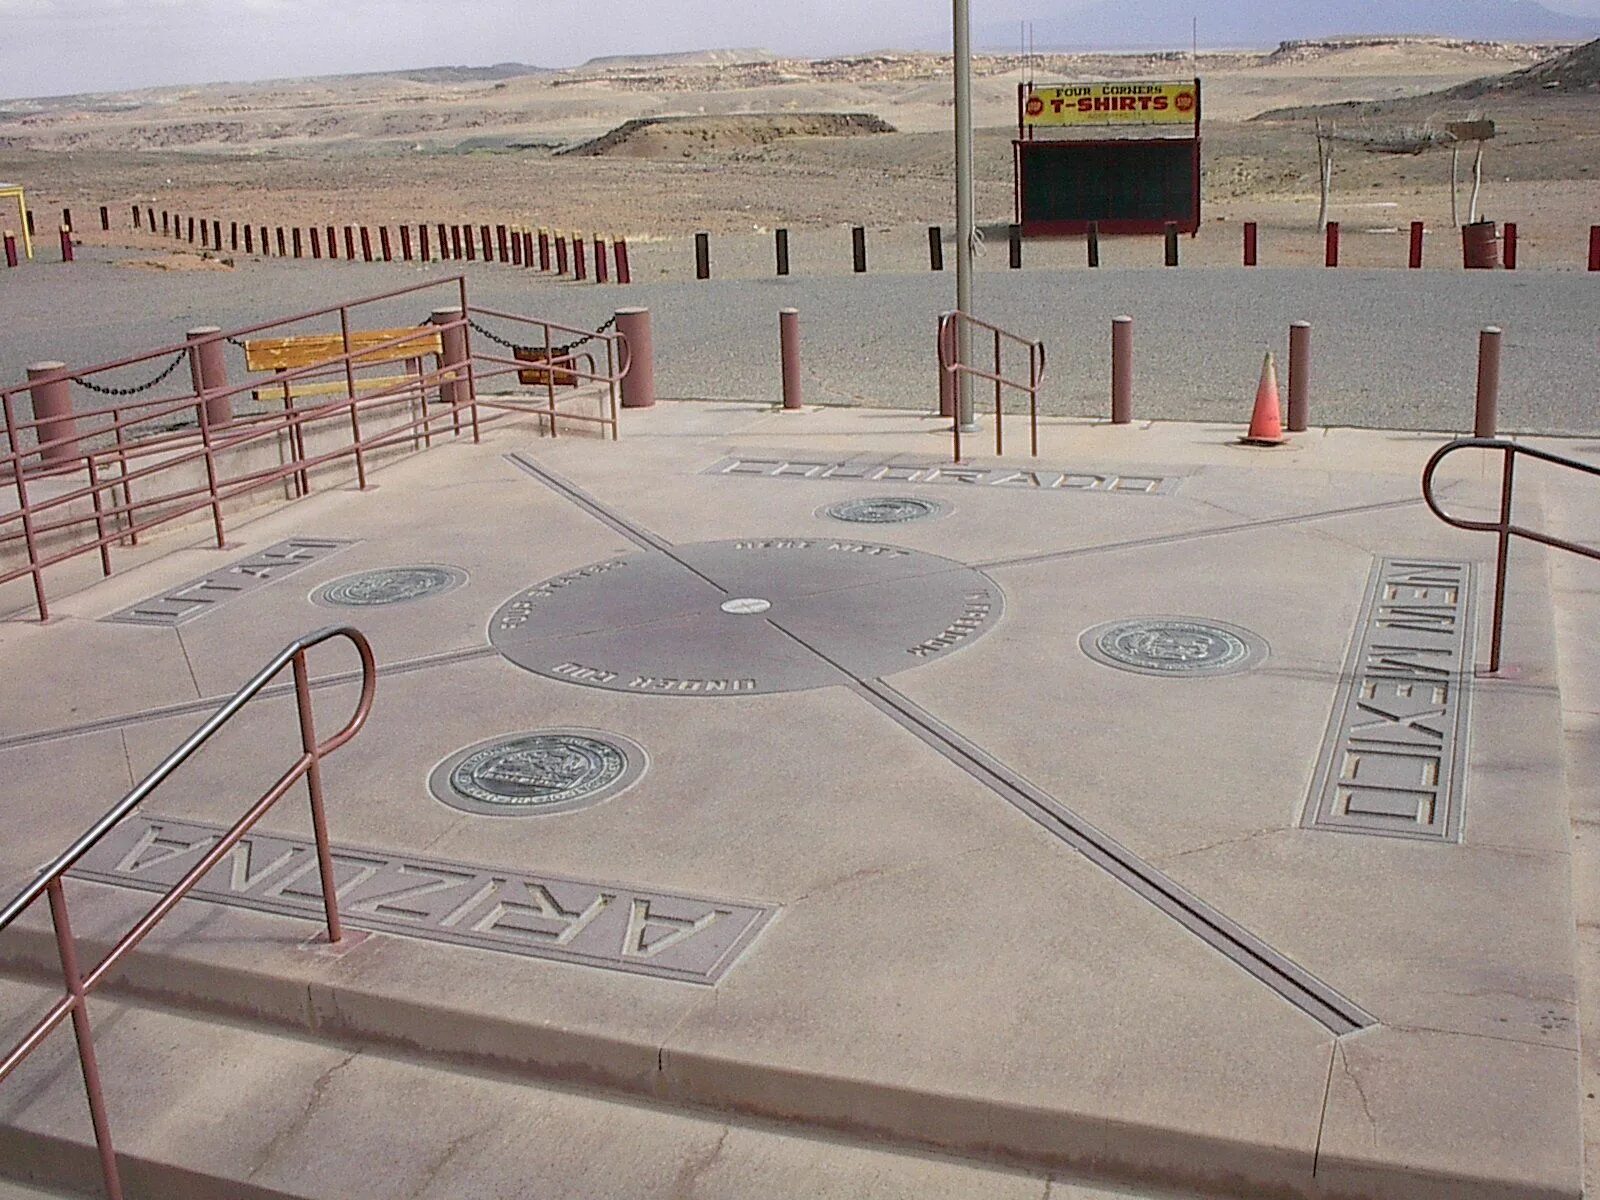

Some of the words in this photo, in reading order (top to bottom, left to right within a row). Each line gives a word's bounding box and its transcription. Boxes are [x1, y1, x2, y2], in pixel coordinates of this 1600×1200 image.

[1051, 96, 1168, 112] T-SHIRTS
[1056, 87, 1091, 97] FOUR
[1102, 85, 1162, 95] CORNERS
[721, 459, 1163, 493] COLORADO
[131, 543, 337, 616] UTAH
[1375, 562, 1462, 635] NEW
[552, 661, 619, 684] GOD
[629, 677, 757, 692] UNDER
[1330, 644, 1453, 825] MEXICO
[115, 825, 732, 958] ARIZONA
